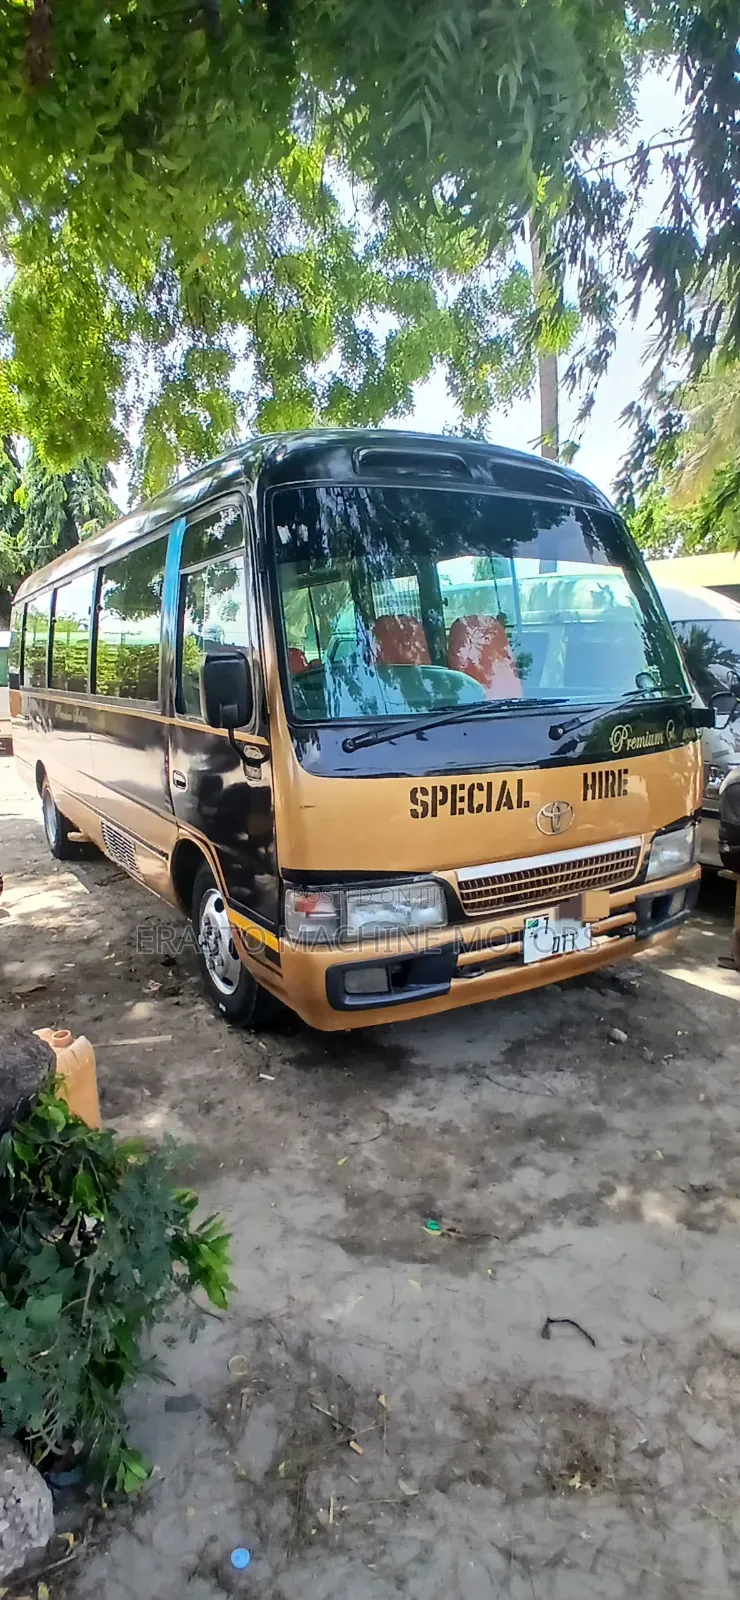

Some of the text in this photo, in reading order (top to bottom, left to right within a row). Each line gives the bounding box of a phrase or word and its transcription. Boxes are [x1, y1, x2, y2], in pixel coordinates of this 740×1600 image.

[608, 724, 664, 753] Premium
[409, 768, 629, 819] SPECIAL HIRE
